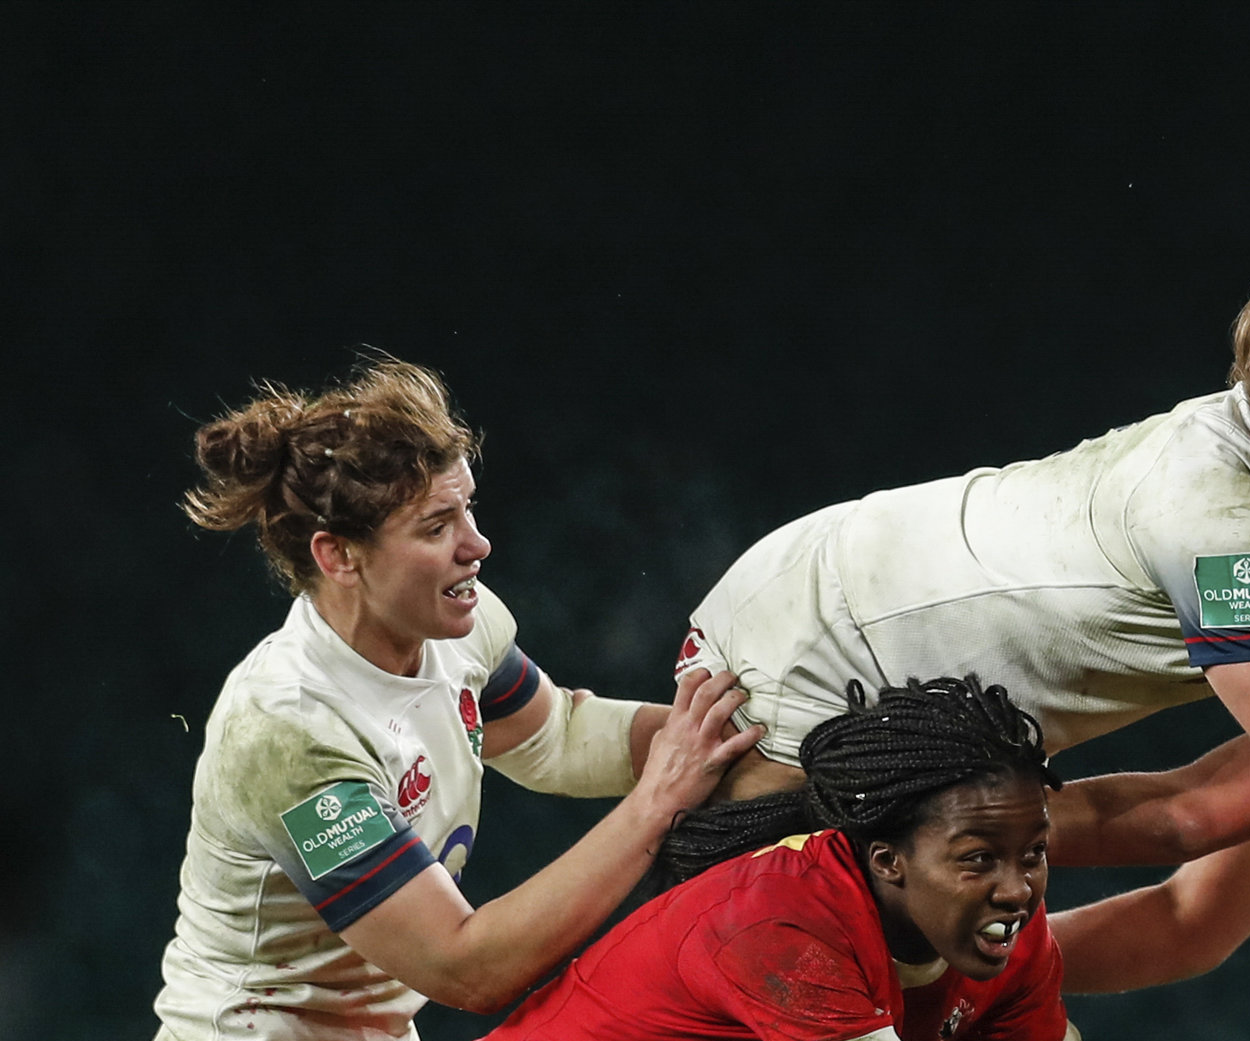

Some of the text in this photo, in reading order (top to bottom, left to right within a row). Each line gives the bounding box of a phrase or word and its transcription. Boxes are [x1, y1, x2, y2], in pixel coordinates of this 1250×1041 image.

[302, 806, 378, 852] OLDMUTUAL
[327, 826, 364, 850] WEALTH
[338, 840, 366, 859] SERIES
